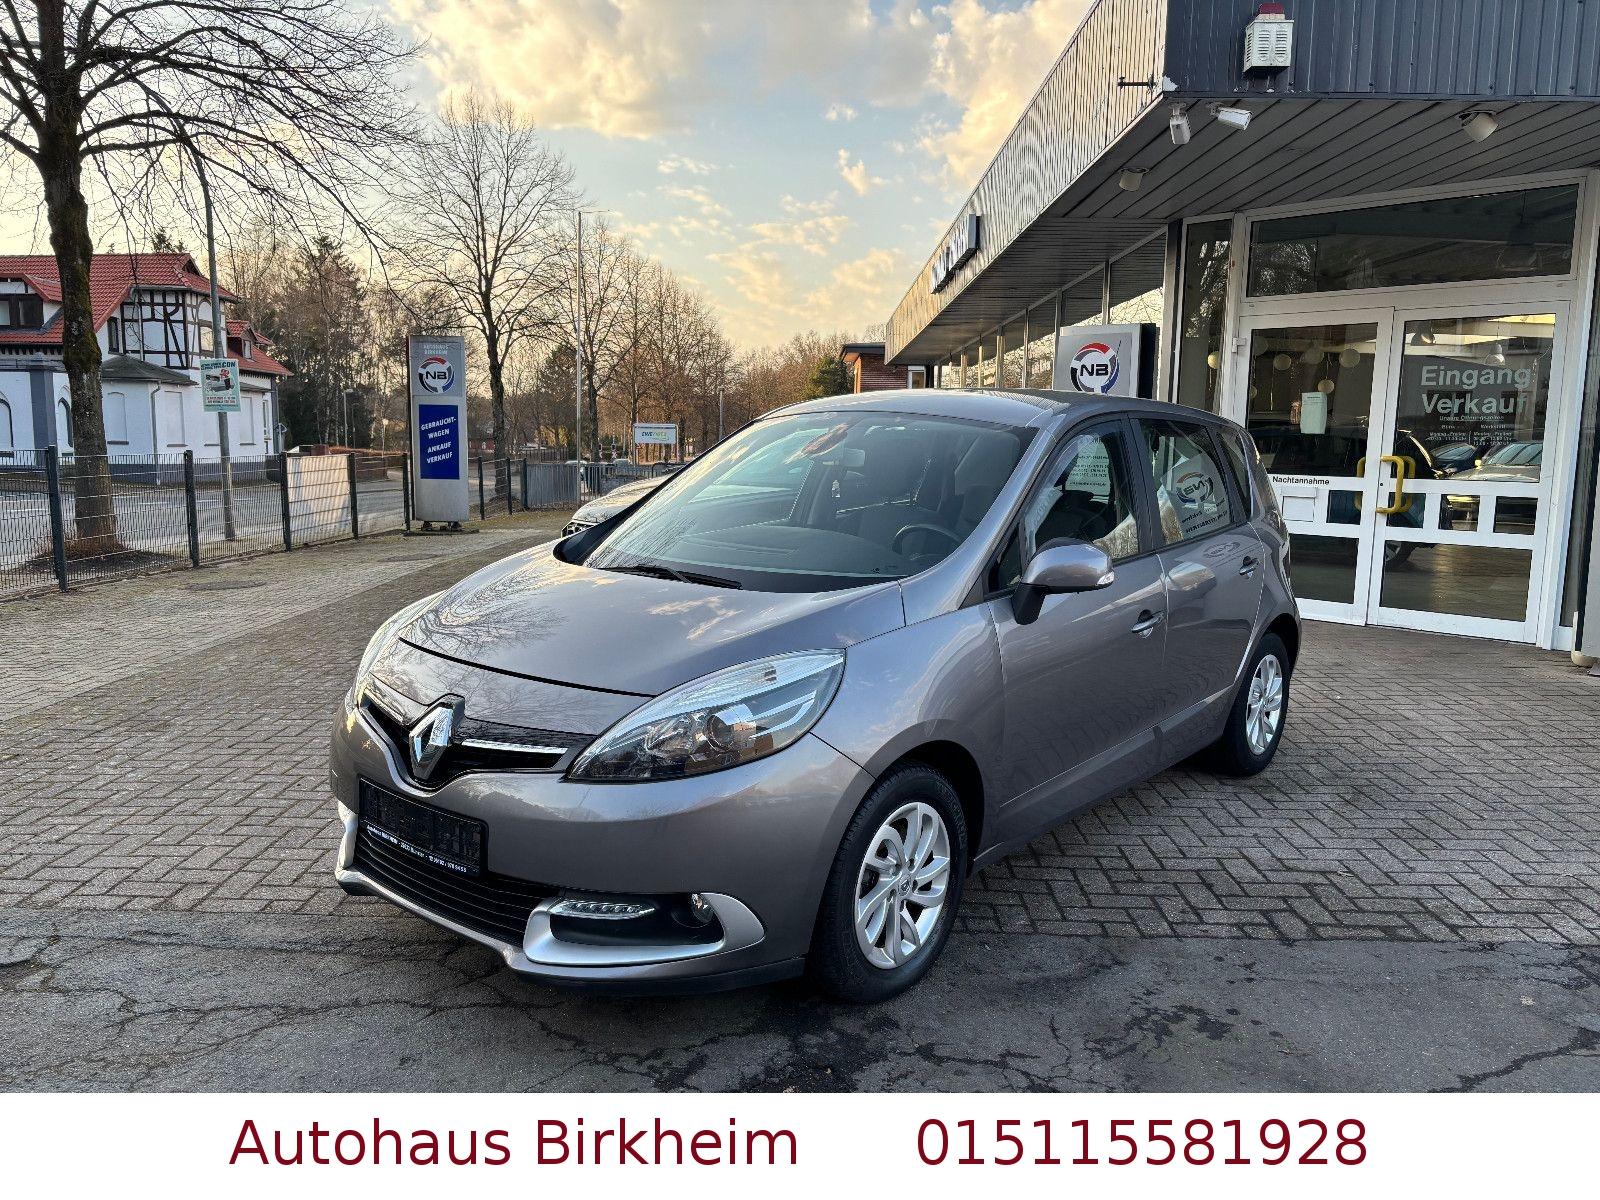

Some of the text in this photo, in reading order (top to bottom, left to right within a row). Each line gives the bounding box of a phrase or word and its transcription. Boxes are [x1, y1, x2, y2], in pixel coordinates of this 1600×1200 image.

[425, 371, 448, 380] NB
[1080, 363, 1109, 377] NB
[1421, 365, 1532, 390] Eingang
[1421, 393, 1529, 414] Verkauf
[421, 416, 457, 431] GEBRAUCHT-
[428, 428, 450, 439] WAGEN
[427, 441, 452, 454] ANKAUF
[426, 451, 453, 464] VERKAUF
[1272, 475, 1330, 486] Nachtannahme
